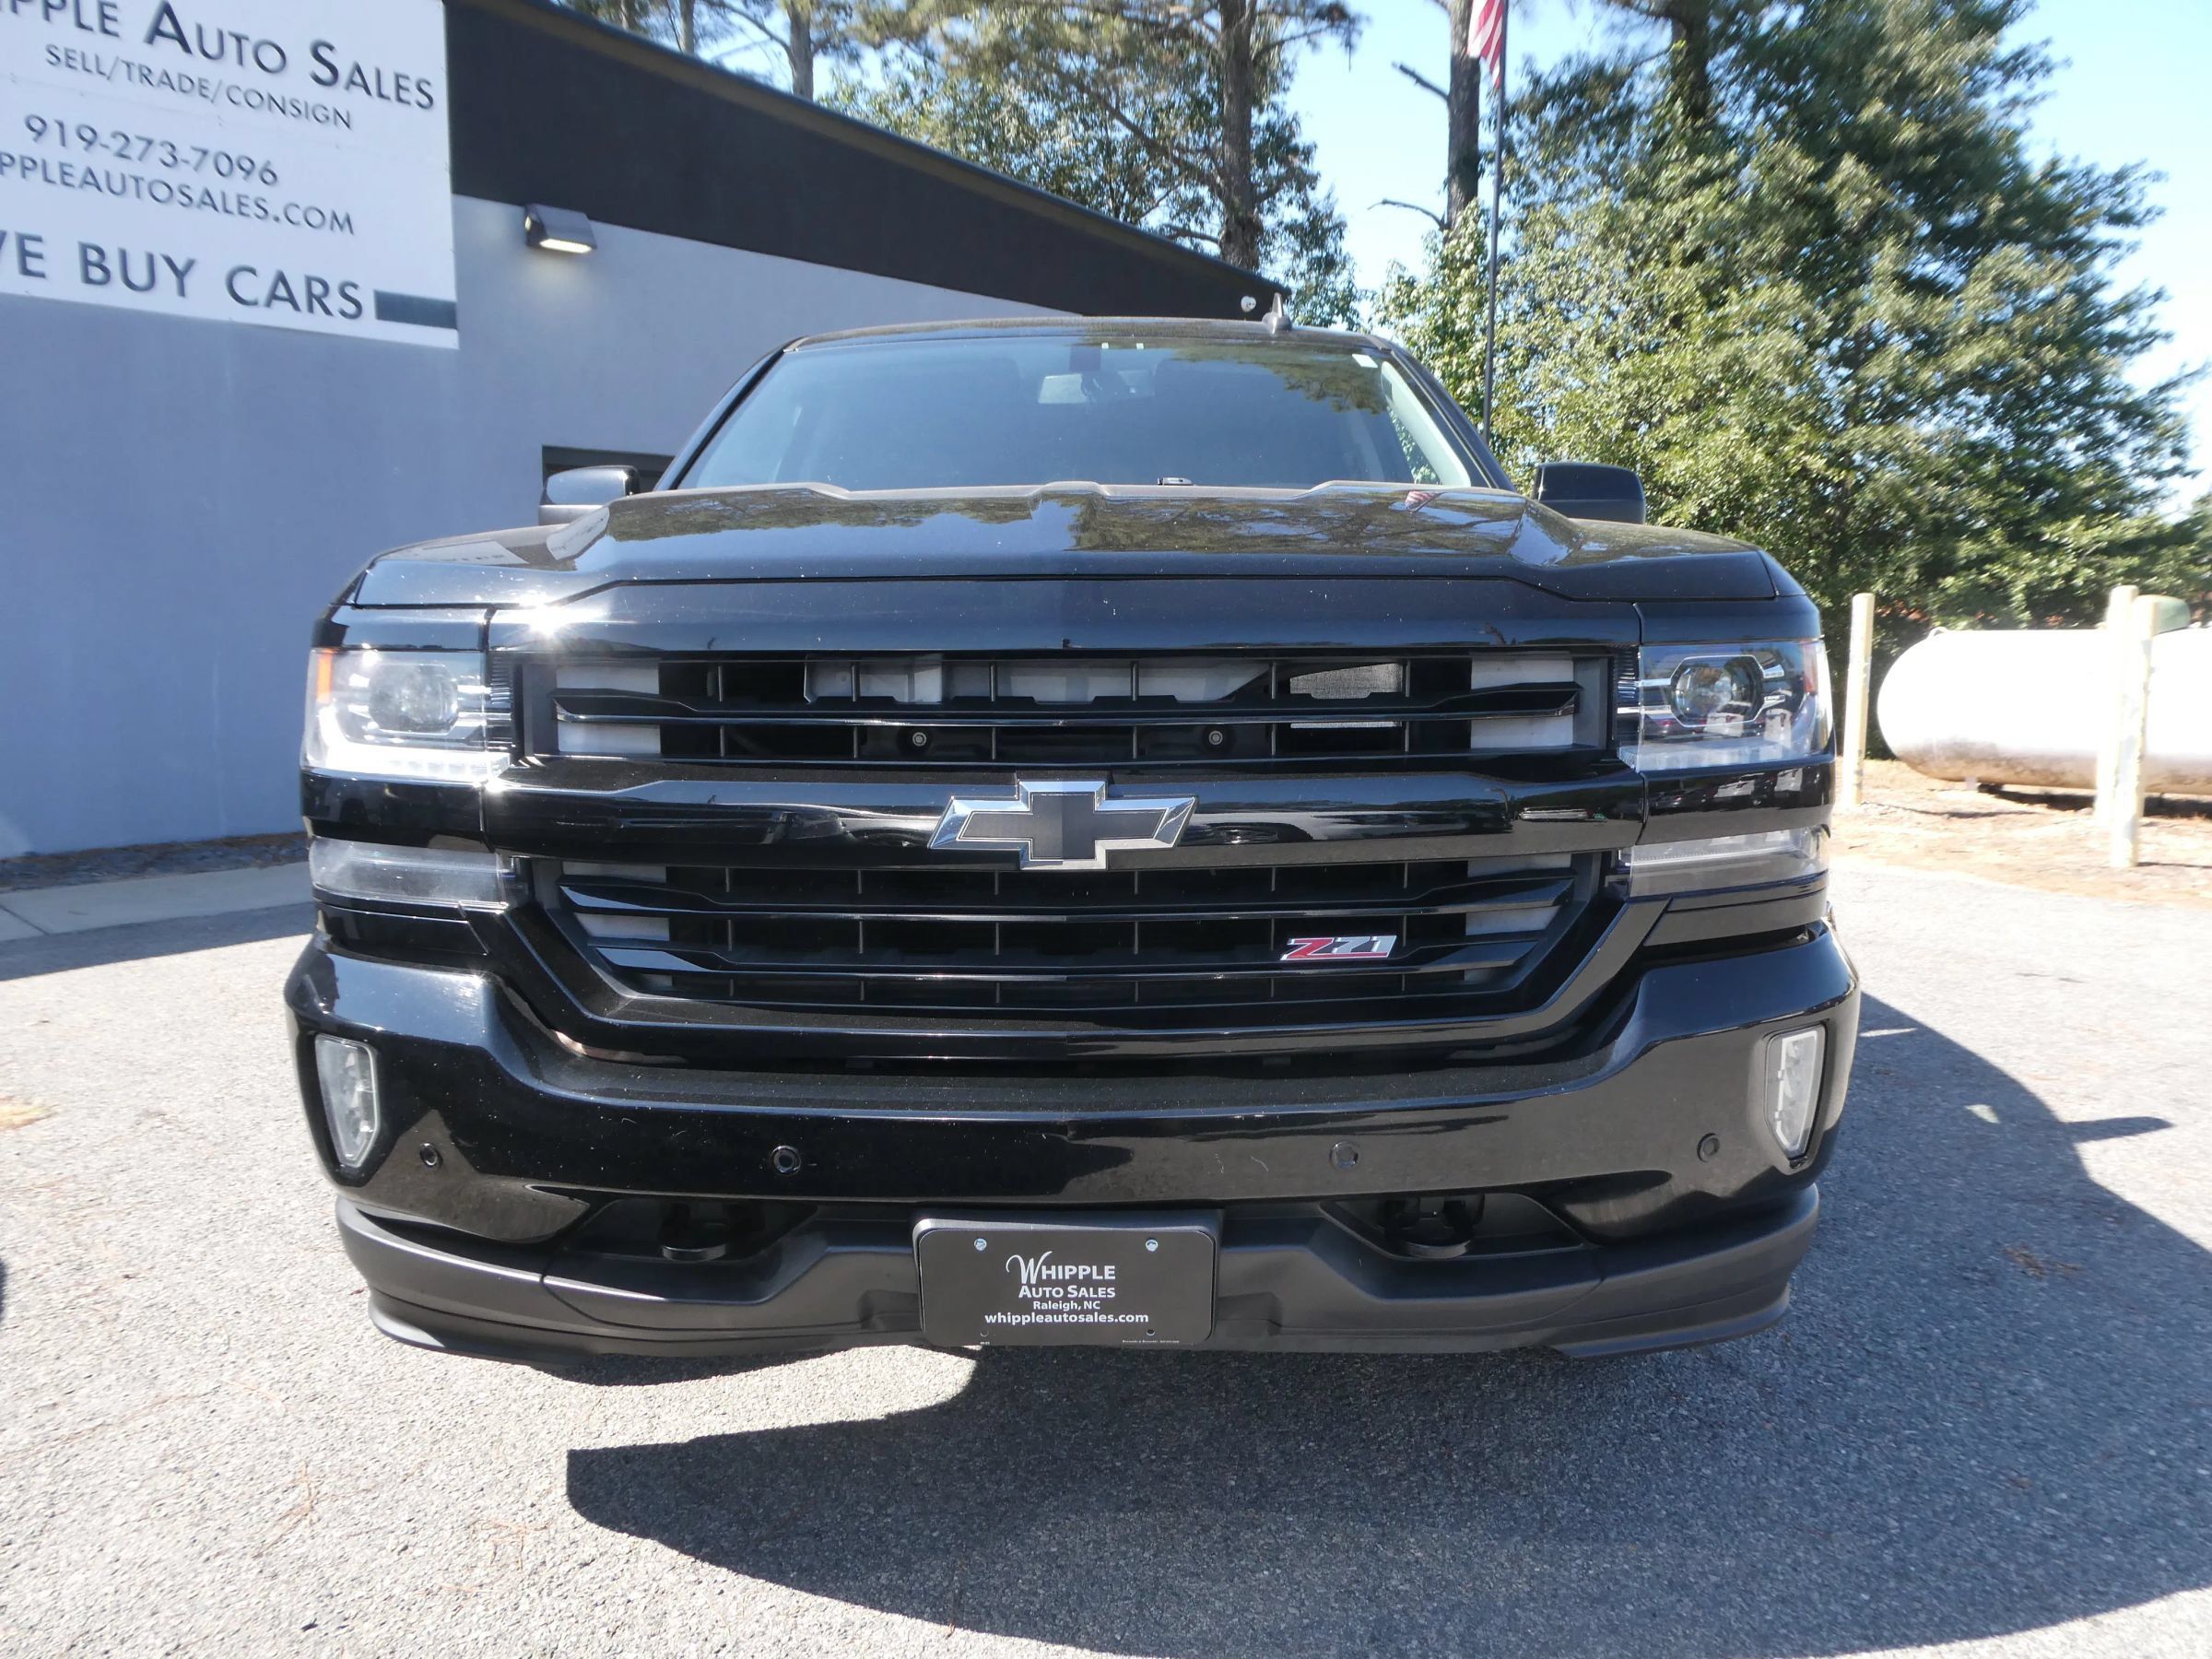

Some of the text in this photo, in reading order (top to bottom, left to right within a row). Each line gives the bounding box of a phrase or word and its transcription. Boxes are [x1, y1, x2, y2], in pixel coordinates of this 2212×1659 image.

[145, 0, 288, 75] AUTO
[310, 40, 434, 112] SALES
[45, 43, 353, 130] SELL/TRADE/CONSIGN
[24, 113, 280, 187] 919-273-7096
[0, 229, 364, 321] E BUY CARS
[1280, 935, 1396, 960] Z71
[1006, 1251, 1116, 1284] WHIPPLE
[1018, 1285, 1116, 1299] AUTO SALES
[1033, 1300, 1100, 1311] Raleigh, NC
[984, 1312, 1149, 1325] whippleautosales.com
